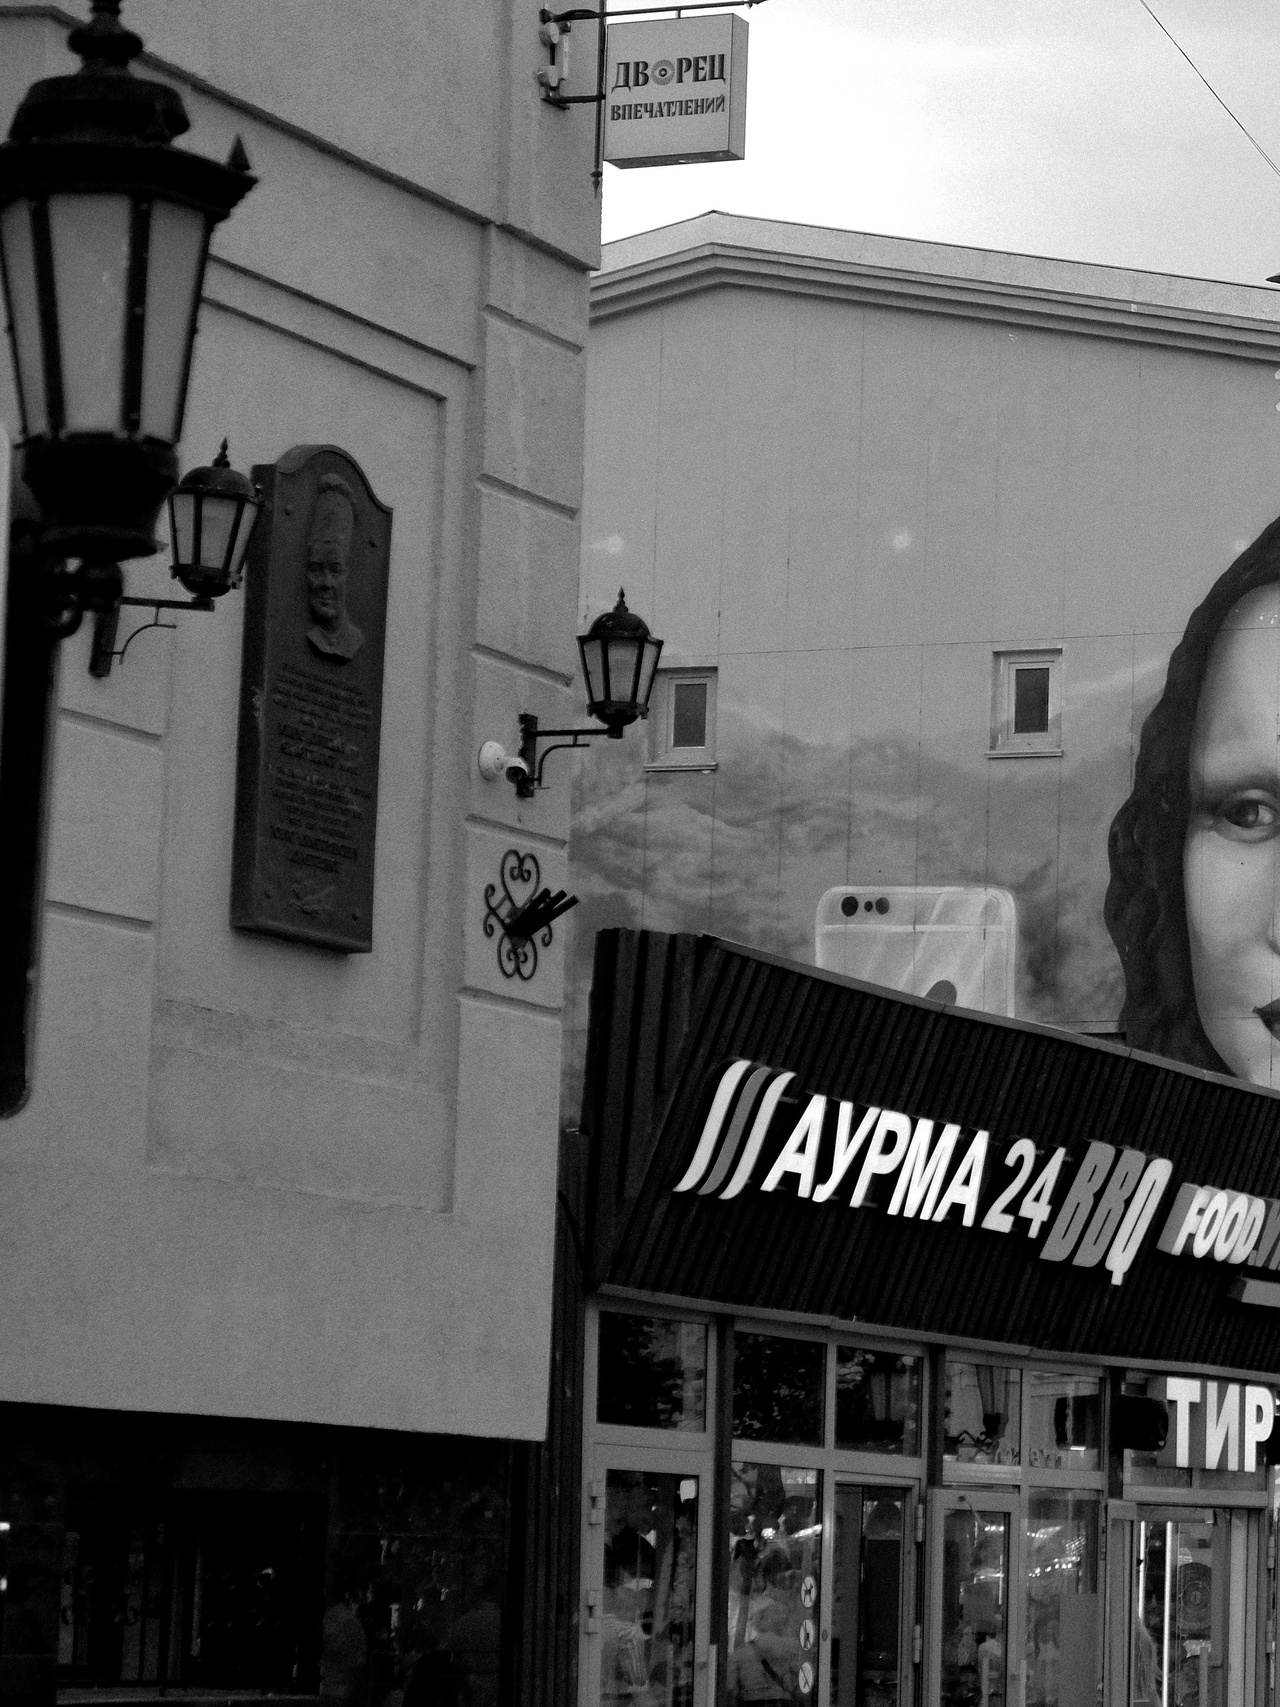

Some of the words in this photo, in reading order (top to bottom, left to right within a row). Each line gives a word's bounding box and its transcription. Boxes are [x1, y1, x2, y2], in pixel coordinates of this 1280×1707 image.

[610, 94, 725, 121] ВПЕЧАТЛЕНИЙ
[981, 1138, 1066, 1239] 24
[1039, 1139, 1173, 1286] BBQ
[1166, 1376, 1274, 1473] ТИР
